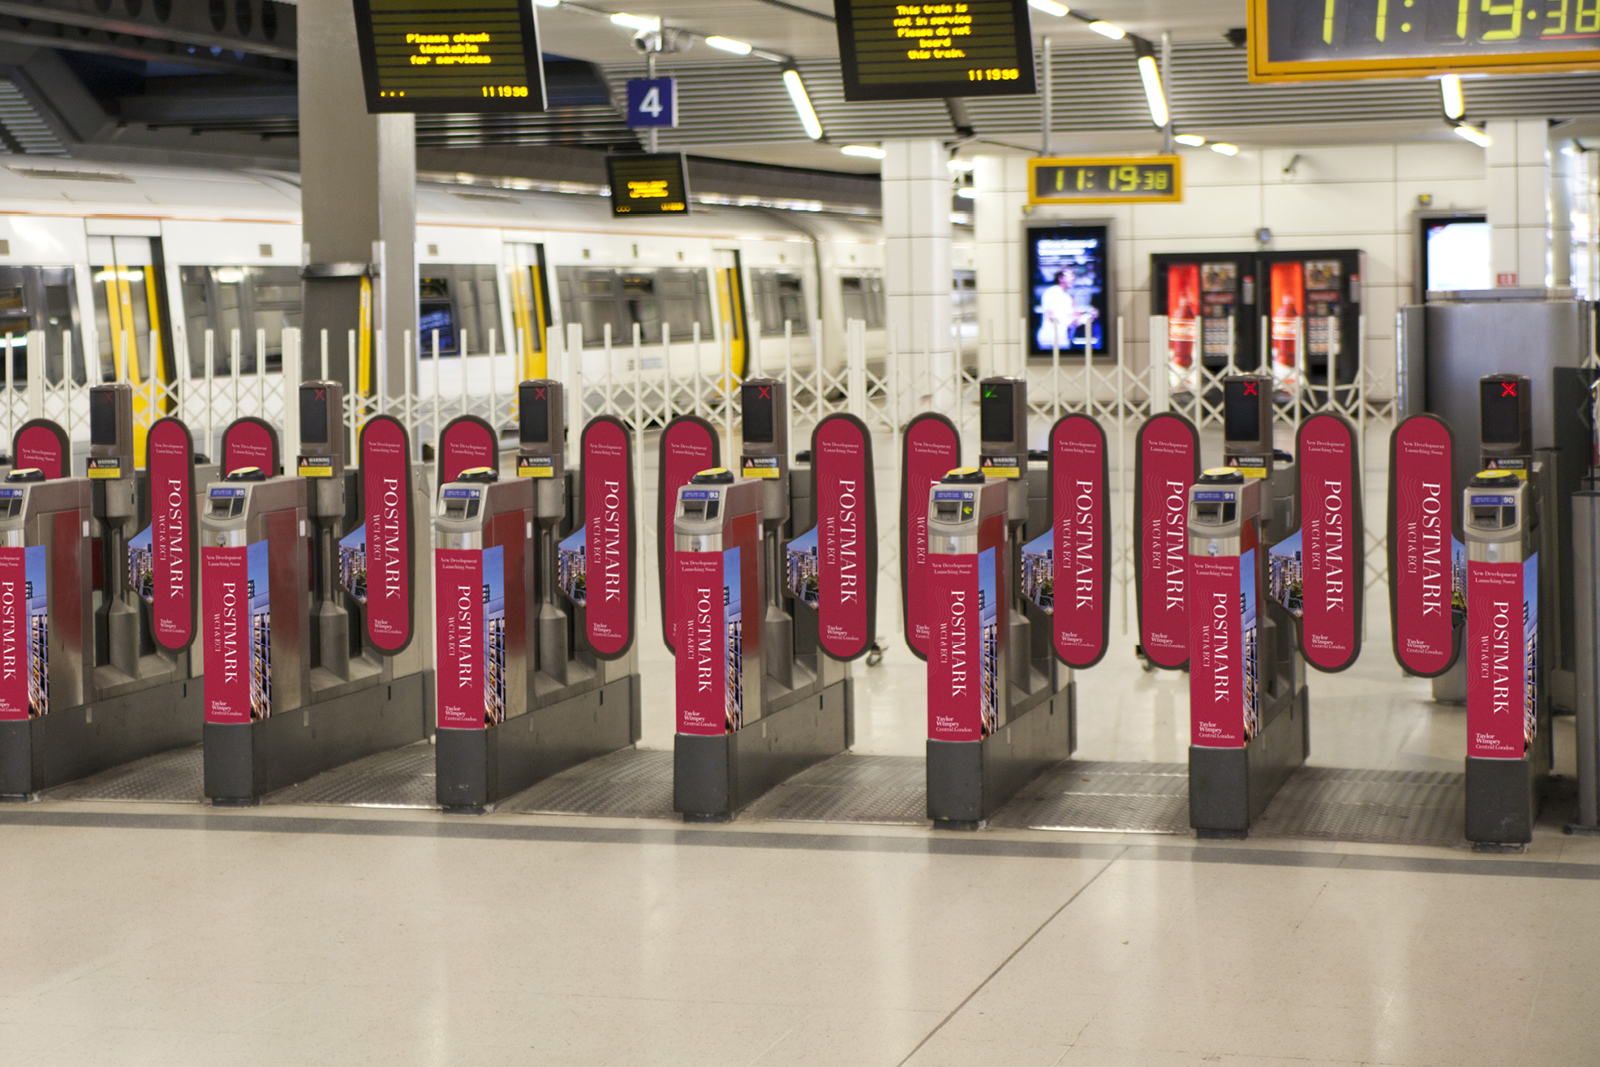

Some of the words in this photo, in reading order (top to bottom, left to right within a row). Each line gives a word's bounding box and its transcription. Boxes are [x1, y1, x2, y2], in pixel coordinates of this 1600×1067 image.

[406, 33, 449, 43] Please
[453, 32, 490, 42] check
[419, 44, 479, 54] timetable
[893, 17, 912, 27] not
[916, 16, 928, 26] in
[930, 15, 972, 25] service
[896, 5, 921, 16] This
[923, 4, 952, 14] train
[955, 3, 968, 13] is
[897, 27, 933, 38] Please
[936, 27, 950, 36] do
[952, 26, 971, 35] not
[907, 50, 931, 60] this
[920, 37, 951, 48] board
[410, 55, 431, 65] for
[436, 55, 491, 64] services
[639, 86, 663, 118] 4
[1414, 441, 1445, 450] Development
[169, 479, 182, 599] POSTMARK
[385, 478, 399, 599] POSTMARK
[605, 480, 620, 603] POSTMARK
[840, 479, 857, 605] POSTMARK
[1064, 542, 1070, 550] &
[1076, 480, 1093, 610] POSTMARK
[1154, 542, 1161, 550] &
[1166, 480, 1183, 611] POSTMARK
[1312, 543, 1320, 551] &
[1325, 480, 1343, 612] POSTMARK
[1408, 546, 1416, 554] &
[1422, 482, 1441, 617] POSTMARK
[3, 581, 15, 680] POSTMARK
[224, 582, 236, 684] POSTMARK
[458, 585, 472, 689] POSTMARK
[698, 588, 711, 693] POSTMARK
[952, 590, 966, 698] POSTMARK
[1214, 592, 1228, 703] POSTMARK
[1493, 601, 1509, 714] POSTMARK
